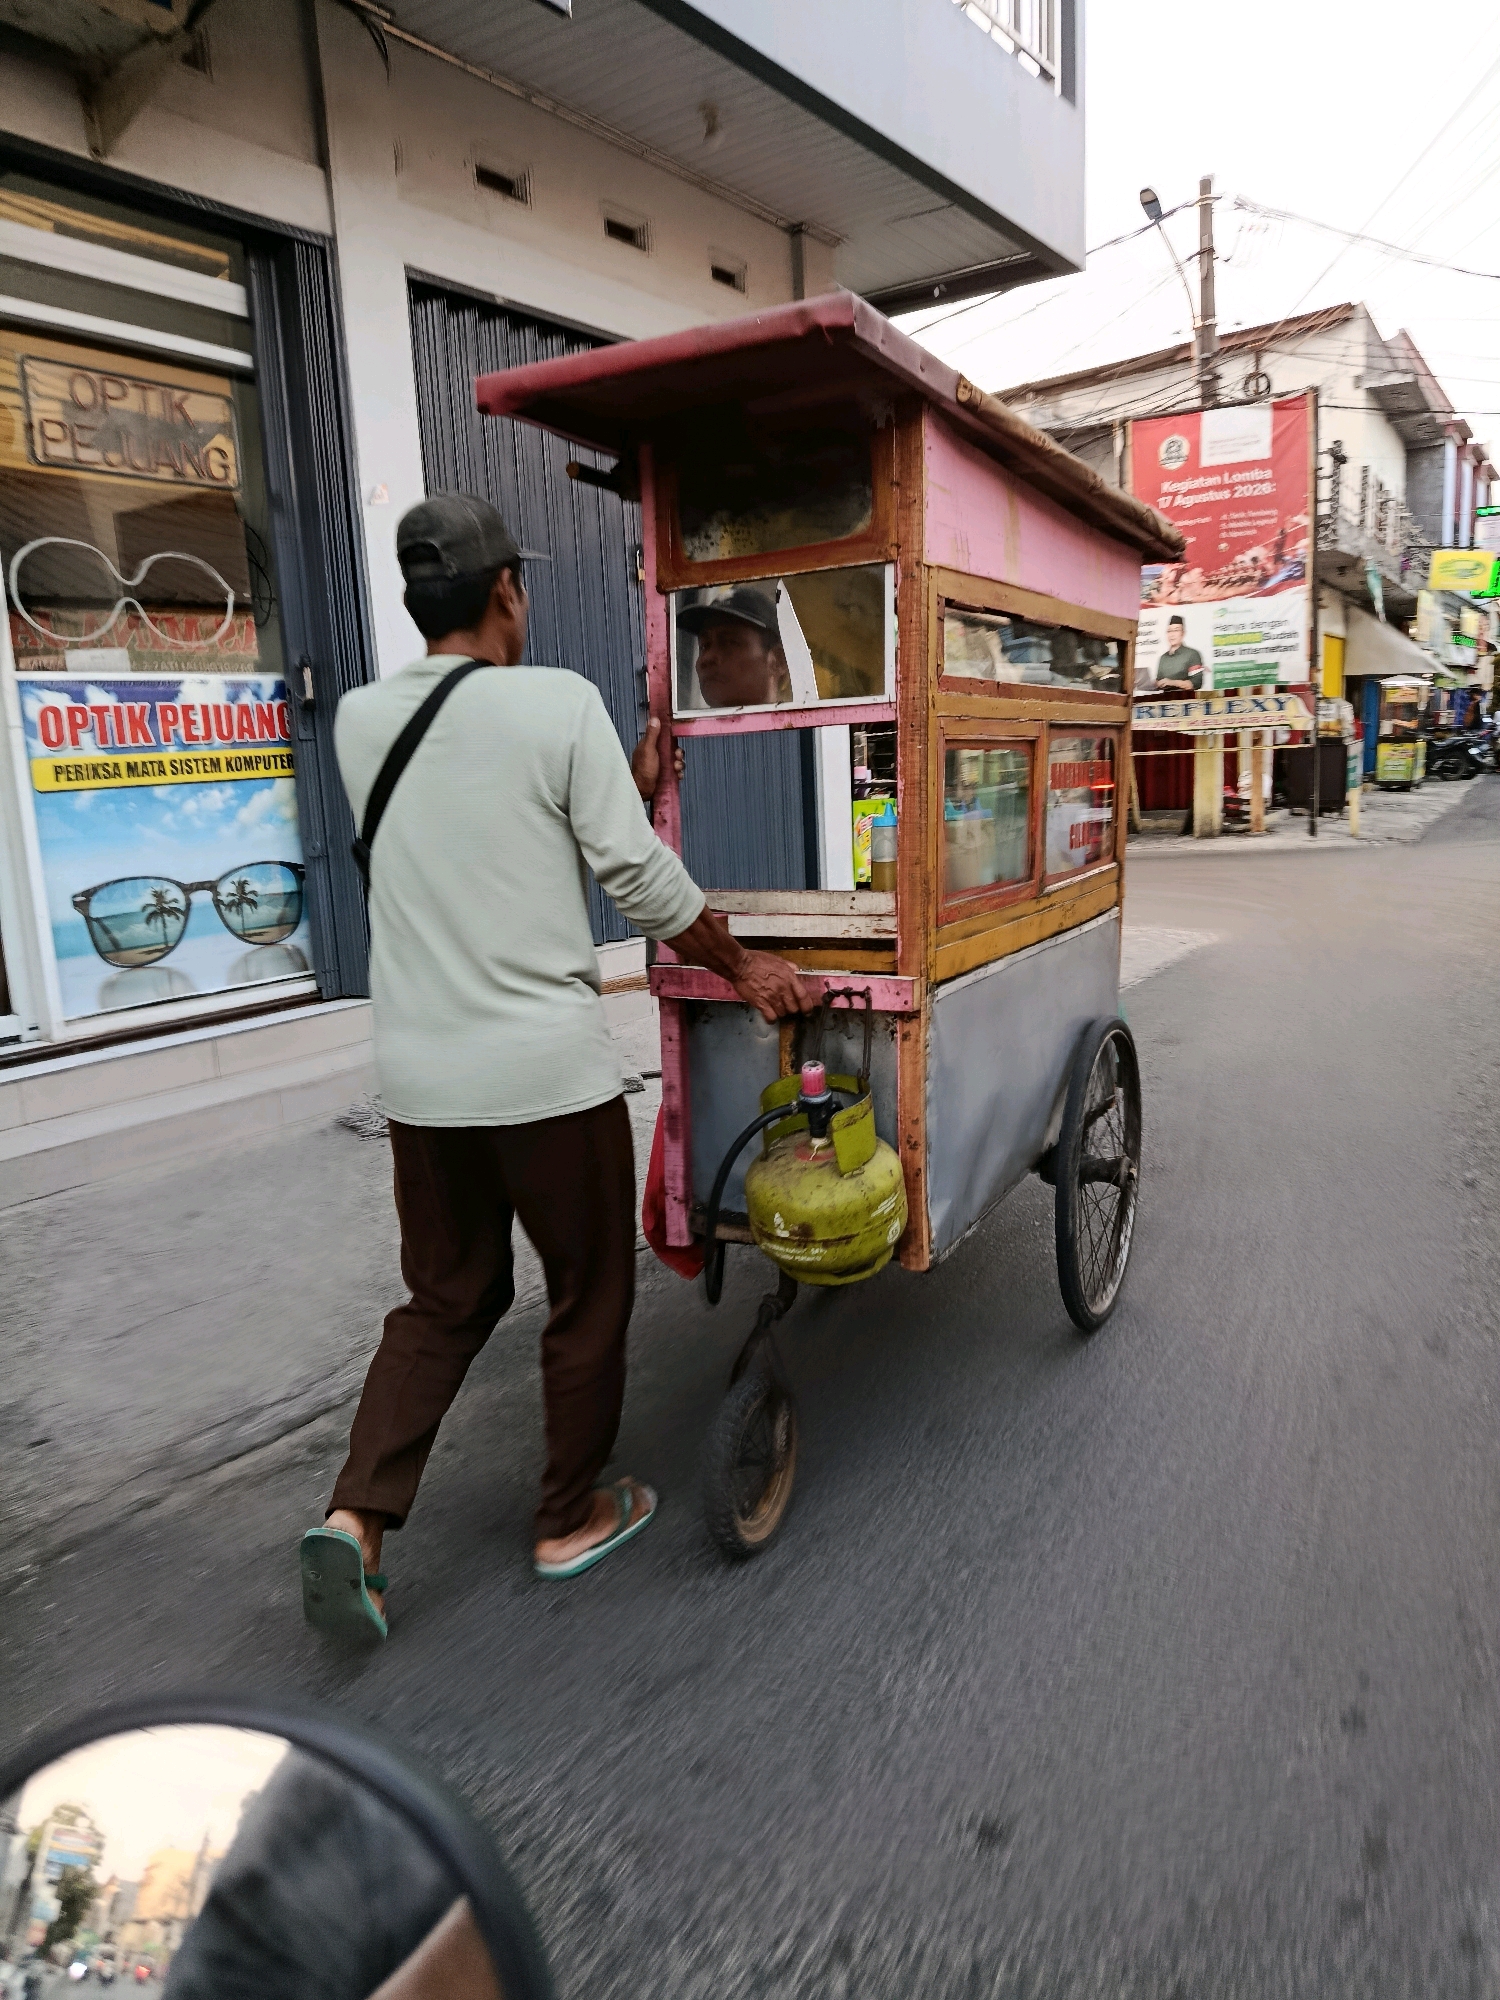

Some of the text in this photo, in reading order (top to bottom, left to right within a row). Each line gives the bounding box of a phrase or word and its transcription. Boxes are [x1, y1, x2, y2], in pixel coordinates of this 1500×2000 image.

[68, 372, 195, 429] OPTIK
[40, 418, 232, 482] PEJUANG
[1160, 468, 1273, 494] Kegiatan Lomba
[1173, 489, 1232, 508] Agustus
[1134, 697, 1294, 719] REFLEXY
[37, 702, 155, 750] OPTIK
[54, 760, 122, 783] PERIKSA
[127, 758, 167, 780] MATA
[170, 757, 222, 777] SISTEM
